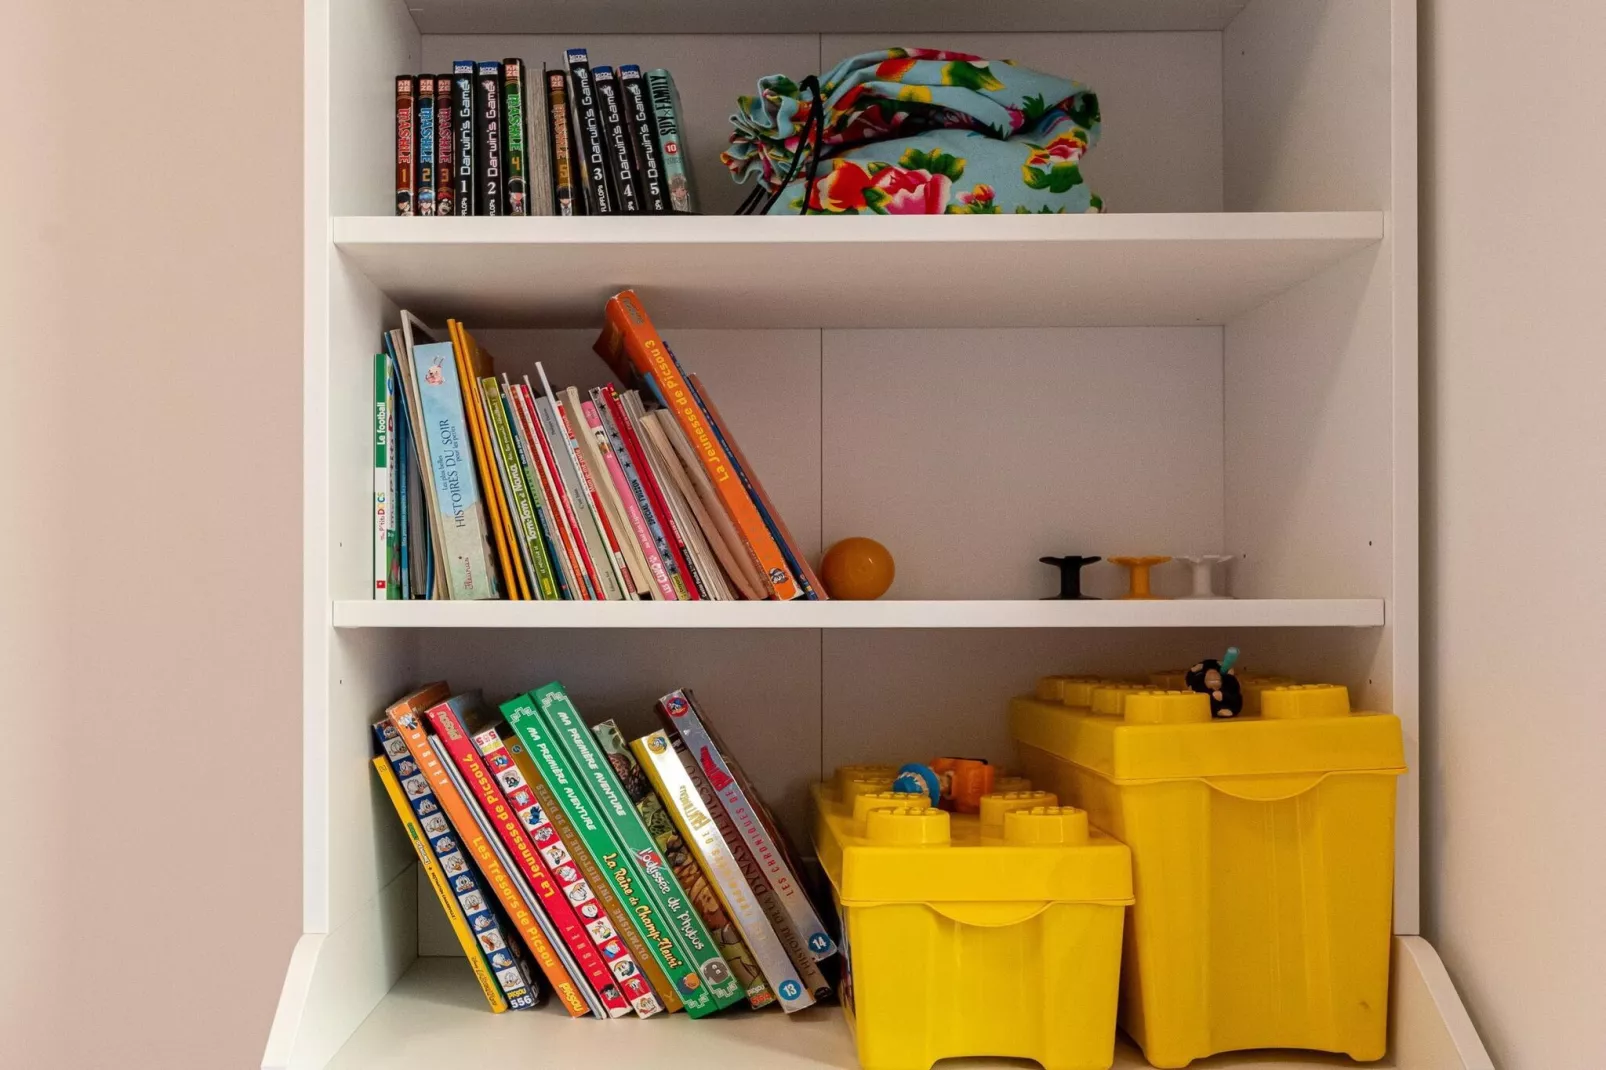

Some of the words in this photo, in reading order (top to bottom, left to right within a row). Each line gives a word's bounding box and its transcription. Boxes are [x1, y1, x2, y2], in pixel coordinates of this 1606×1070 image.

[580, 70, 592, 106] Game
[650, 75, 672, 110] FAMILY
[460, 81, 471, 117] Game
[486, 82, 497, 118] Game
[606, 87, 620, 123] Game
[633, 87, 646, 121] Game
[585, 108, 602, 163] Darwin's
[658, 114, 677, 136] SPY
[460, 120, 471, 175] Darwin's
[486, 121, 498, 177] Darwin's
[612, 125, 632, 180] Darwin's
[640, 124, 659, 178] Darwin's
[666, 143, 677, 153] 10
[512, 156, 520, 170] 4
[559, 164, 568, 177] 5
[402, 169, 407, 182] 1
[422, 169, 430, 182] 2
[441, 169, 449, 182] 3
[593, 168, 603, 180] 3
[461, 180, 468, 193] 1
[488, 181, 496, 194] 2
[624, 184, 632, 196] 4
[650, 182, 659, 195] 5
[644, 339, 655, 348] 3
[651, 348, 678, 388] Picsou
[674, 390, 687, 405] de
[376, 402, 385, 432] football
[376, 434, 385, 444] Le
[439, 419, 452, 444] SOIR
[684, 407, 719, 461] Jeunesse
[436, 454, 444, 469] belles
[444, 452, 456, 467] DU
[439, 469, 447, 481] plus
[510, 463, 524, 492] Nana
[716, 465, 729, 481] La
[447, 470, 465, 527] HISTOIRES
[519, 498, 536, 541] Tom-Tom
[651, 562, 667, 582] CINQ
[662, 583, 671, 593] LES
[411, 732, 448, 787] DISNEY
[461, 752, 474, 763] 4
[557, 711, 571, 725] MA
[567, 727, 598, 769] PREMIÈRE
[593, 772, 626, 815] AVENTURE
[471, 763, 498, 804] Picsou
[526, 727, 540, 740] MA
[536, 742, 567, 783] PREMIÈRE
[563, 787, 596, 830] AVENTURE
[535, 783, 558, 813] DATES
[725, 791, 737, 803] DE
[495, 804, 510, 822] de
[554, 813, 565, 825] 30
[560, 825, 574, 839] EN
[702, 831, 713, 844] DE
[735, 807, 779, 872] CHRONIQUES
[506, 821, 544, 879] Jeunesse
[570, 839, 600, 882] HISTOIRE
[719, 824, 768, 897] DYNASTIE
[540, 880, 554, 897] La
[596, 883, 612, 902] UNE
[777, 877, 793, 896] LES
[472, 836, 490, 859] Les
[488, 859, 519, 908] Trésors
[516, 907, 529, 925] de
[526, 926, 554, 967] Picsou
[602, 853, 617, 868] La
[614, 868, 634, 894] Reine
[628, 897, 639, 906] de
[635, 905, 683, 969] Champ-Fleuri
[666, 895, 682, 912] du
[676, 910, 703, 949] Phobos
[771, 909, 783, 924] DE
[612, 908, 648, 959] OLYMPISME
[812, 936, 827, 950] 14
[558, 982, 583, 1012] PICSOU
[783, 983, 797, 997] 13
[510, 995, 532, 1009] 556
